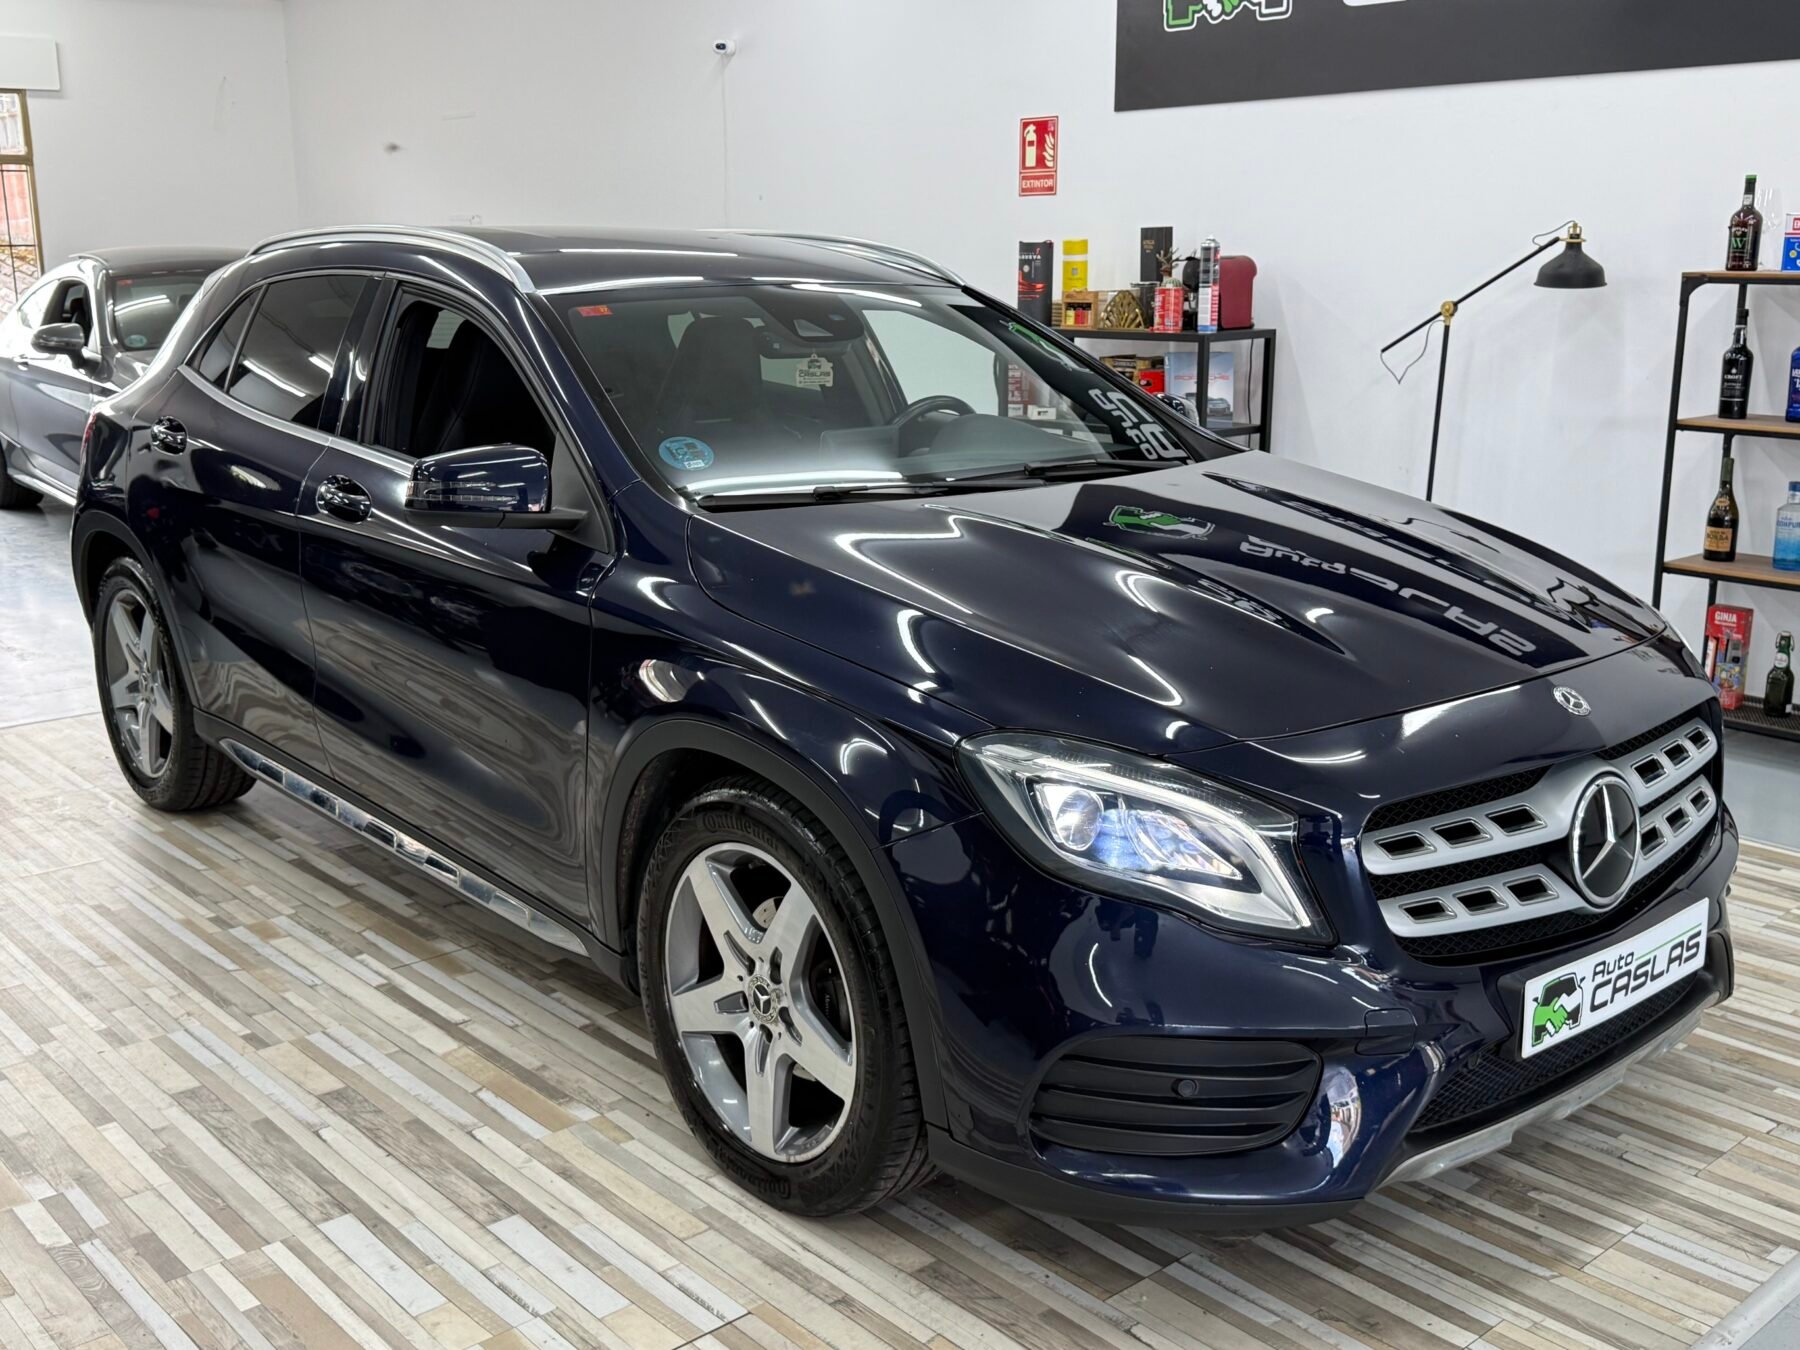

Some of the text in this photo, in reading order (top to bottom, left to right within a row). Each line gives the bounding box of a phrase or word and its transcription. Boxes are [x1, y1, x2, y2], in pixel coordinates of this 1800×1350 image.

[1022, 179, 1053, 188] EXTINTOR
[1715, 611, 1737, 623] GINJA
[1589, 930, 1702, 1013] CASLAS
[1592, 951, 1635, 982] Auto
